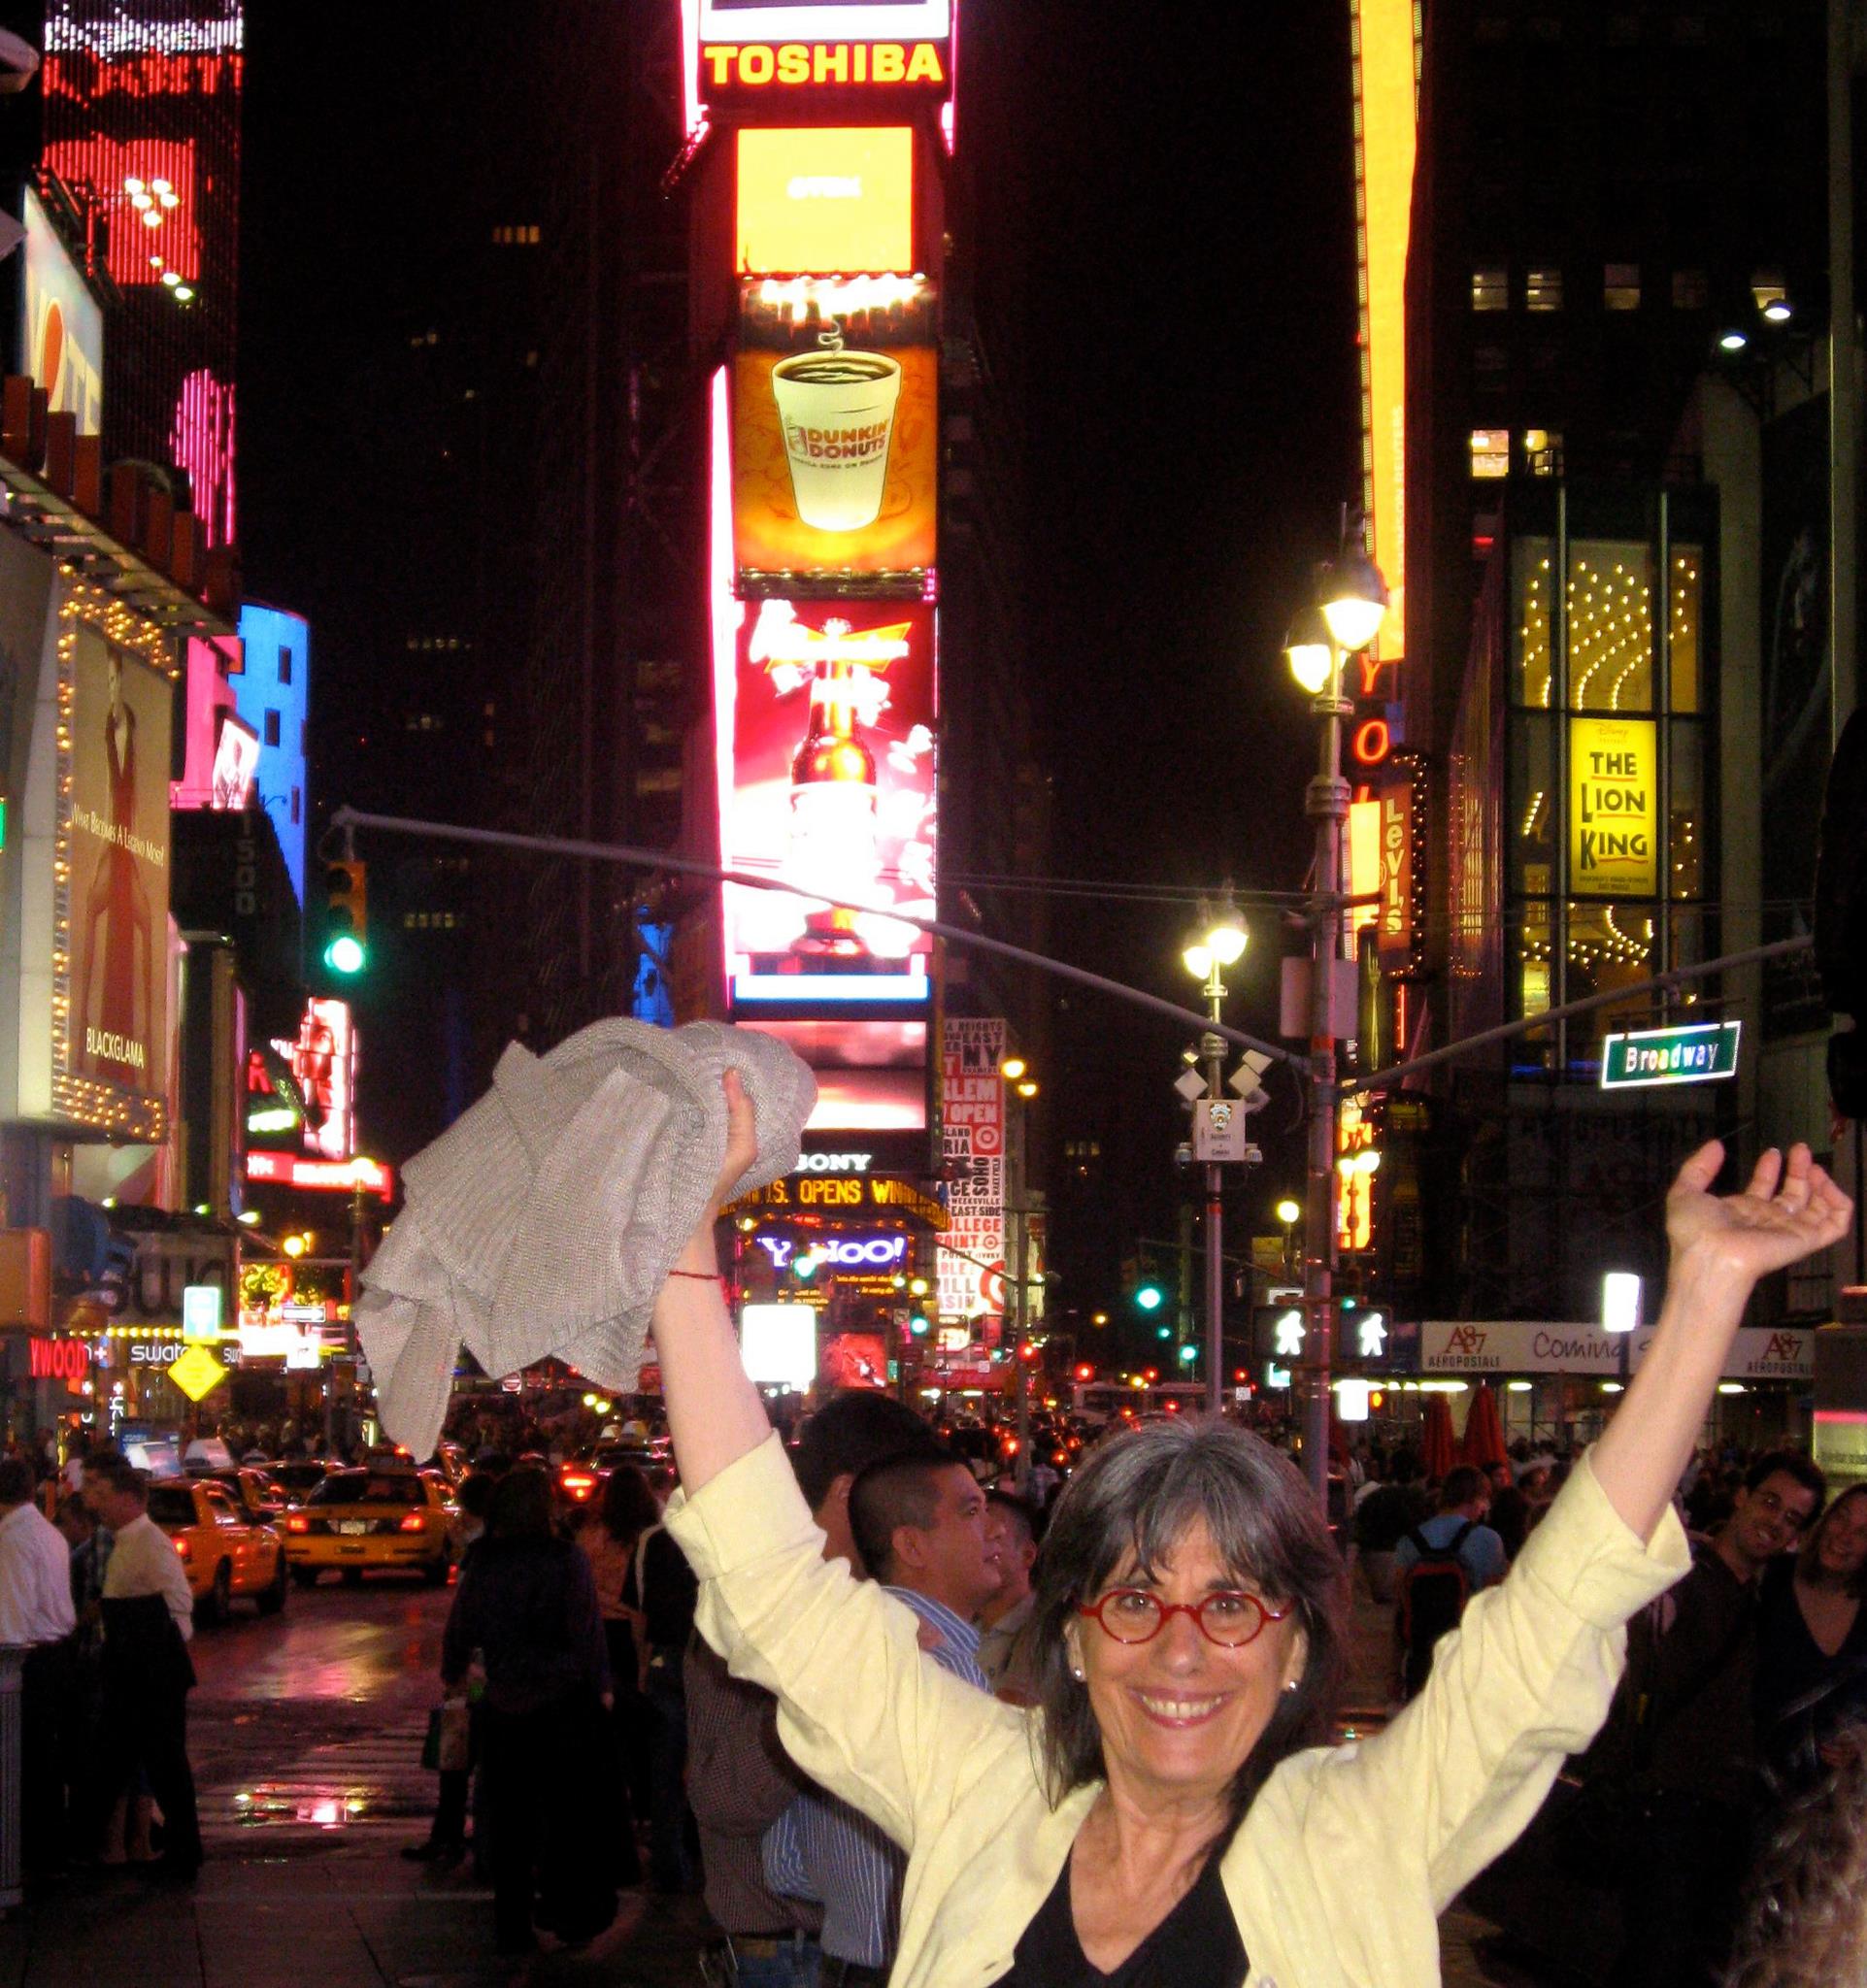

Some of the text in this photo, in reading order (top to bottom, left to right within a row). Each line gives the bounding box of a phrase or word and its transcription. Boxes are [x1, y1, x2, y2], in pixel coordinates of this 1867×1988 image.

[704, 44, 944, 84] TOSHIBA
[808, 435, 886, 459] DONUTS
[1589, 751, 1638, 776] THE
[1581, 782, 1646, 823] LION
[117, 824, 124, 847] A
[1580, 829, 1649, 871] KING
[85, 1027, 145, 1069] BLACKGLAMA
[1625, 1043, 1718, 1074] Broadway
[950, 1103, 998, 1123] OPEN
[972, 1157, 989, 1196] SOHO
[800, 1178, 862, 1204] OPENS
[951, 1206, 1002, 1217] EAST SIDE
[756, 1237, 905, 1267] YHOO!
[934, 1234, 979, 1249] POINT
